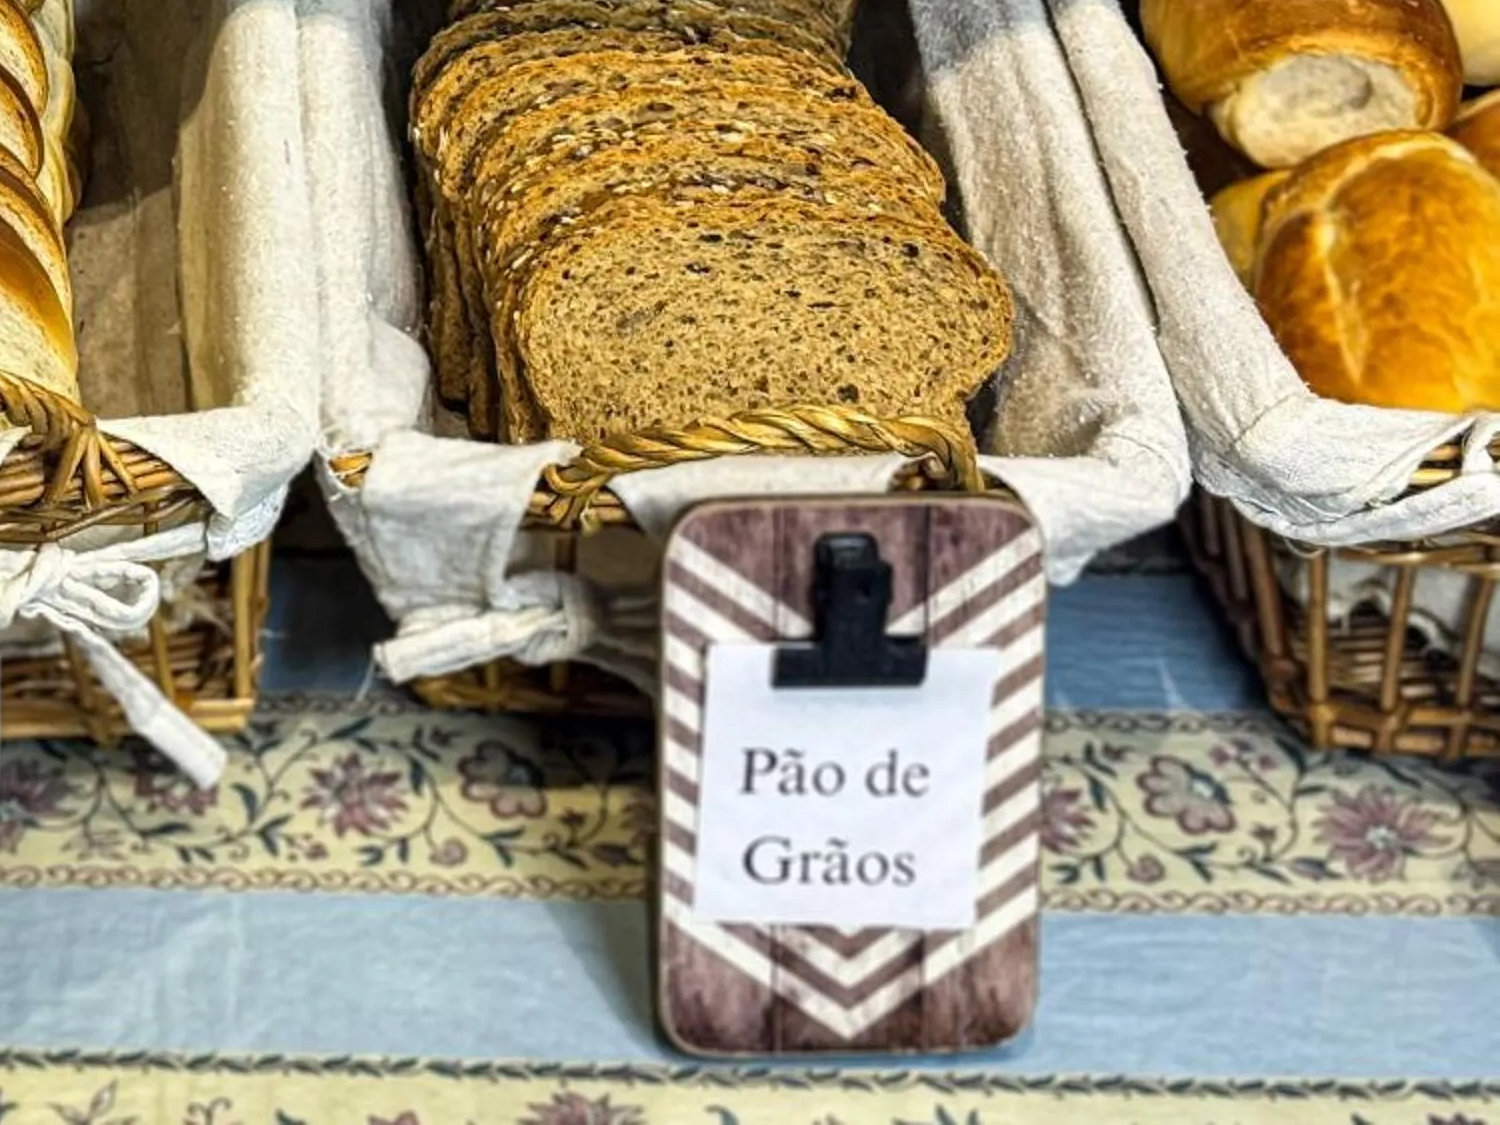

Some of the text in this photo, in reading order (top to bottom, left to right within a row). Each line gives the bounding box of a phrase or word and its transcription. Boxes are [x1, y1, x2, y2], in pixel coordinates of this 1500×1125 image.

[739, 747, 930, 798] Pão de
[742, 835, 917, 886] Grãos
